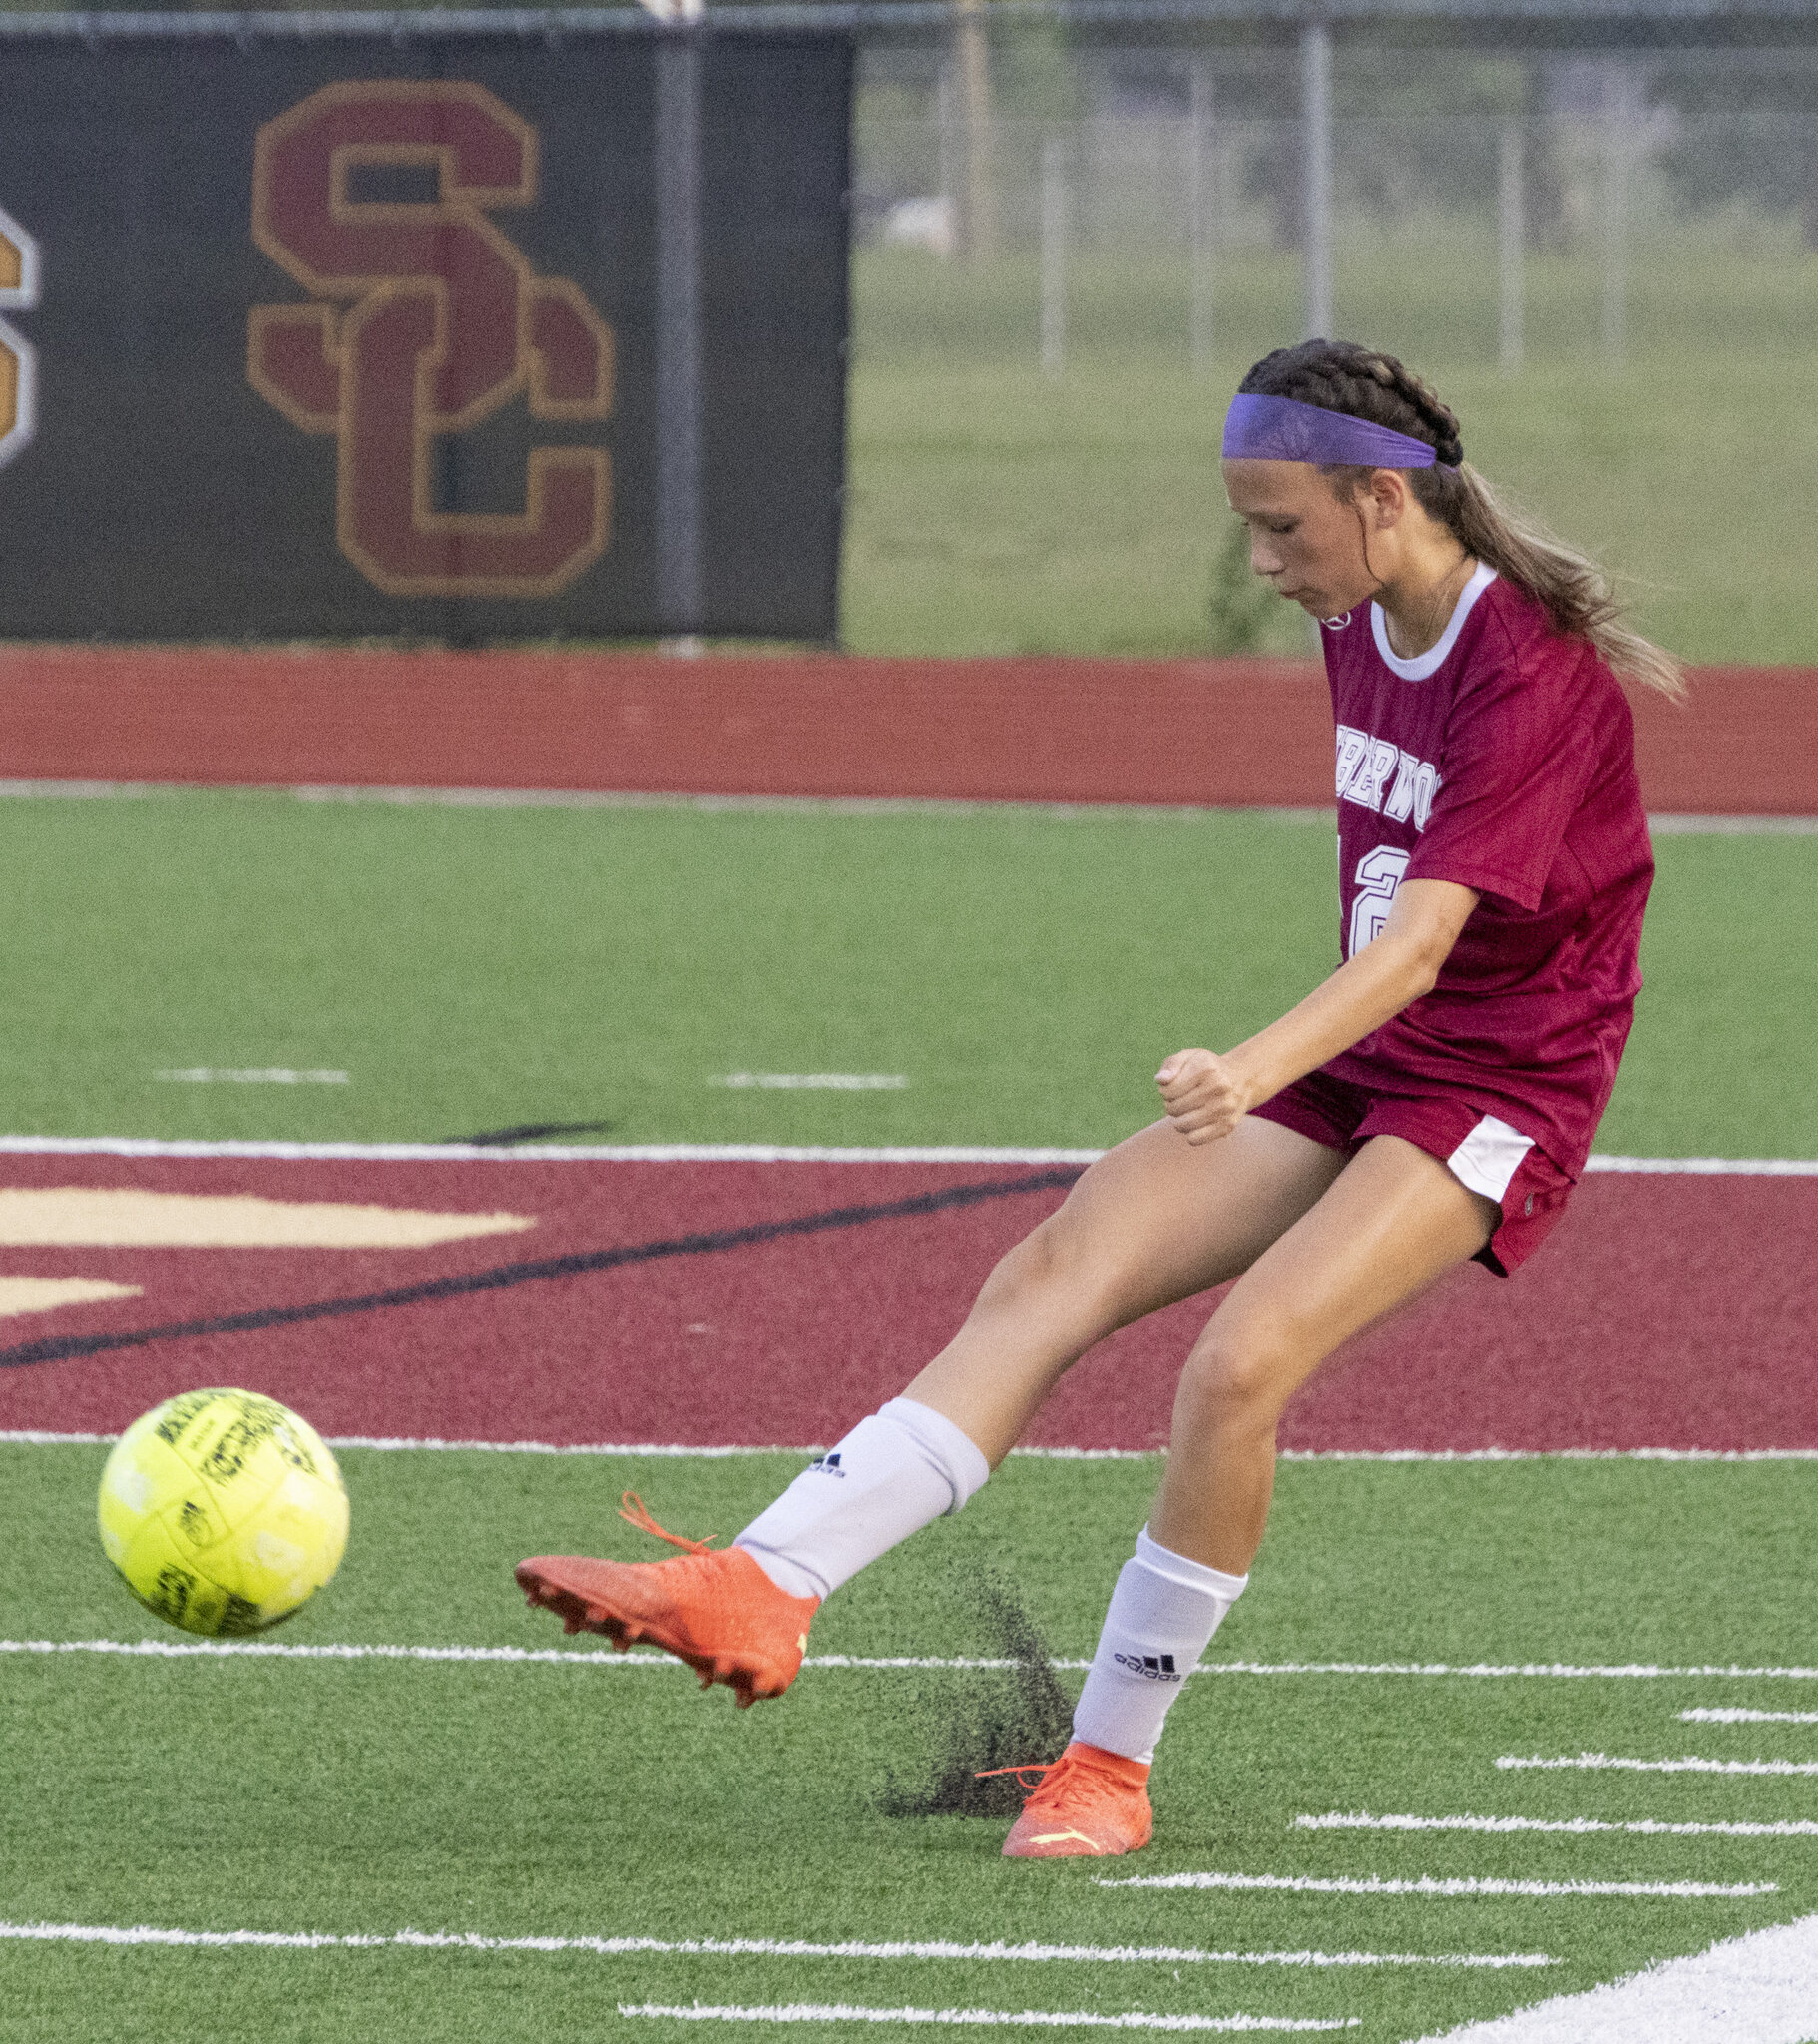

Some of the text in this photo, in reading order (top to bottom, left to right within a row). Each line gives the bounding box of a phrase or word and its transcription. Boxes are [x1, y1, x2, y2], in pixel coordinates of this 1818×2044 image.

[1336, 724, 1443, 834] BERWO
[1337, 835, 1411, 958] 2
[1114, 1653, 1181, 1682] adidas
